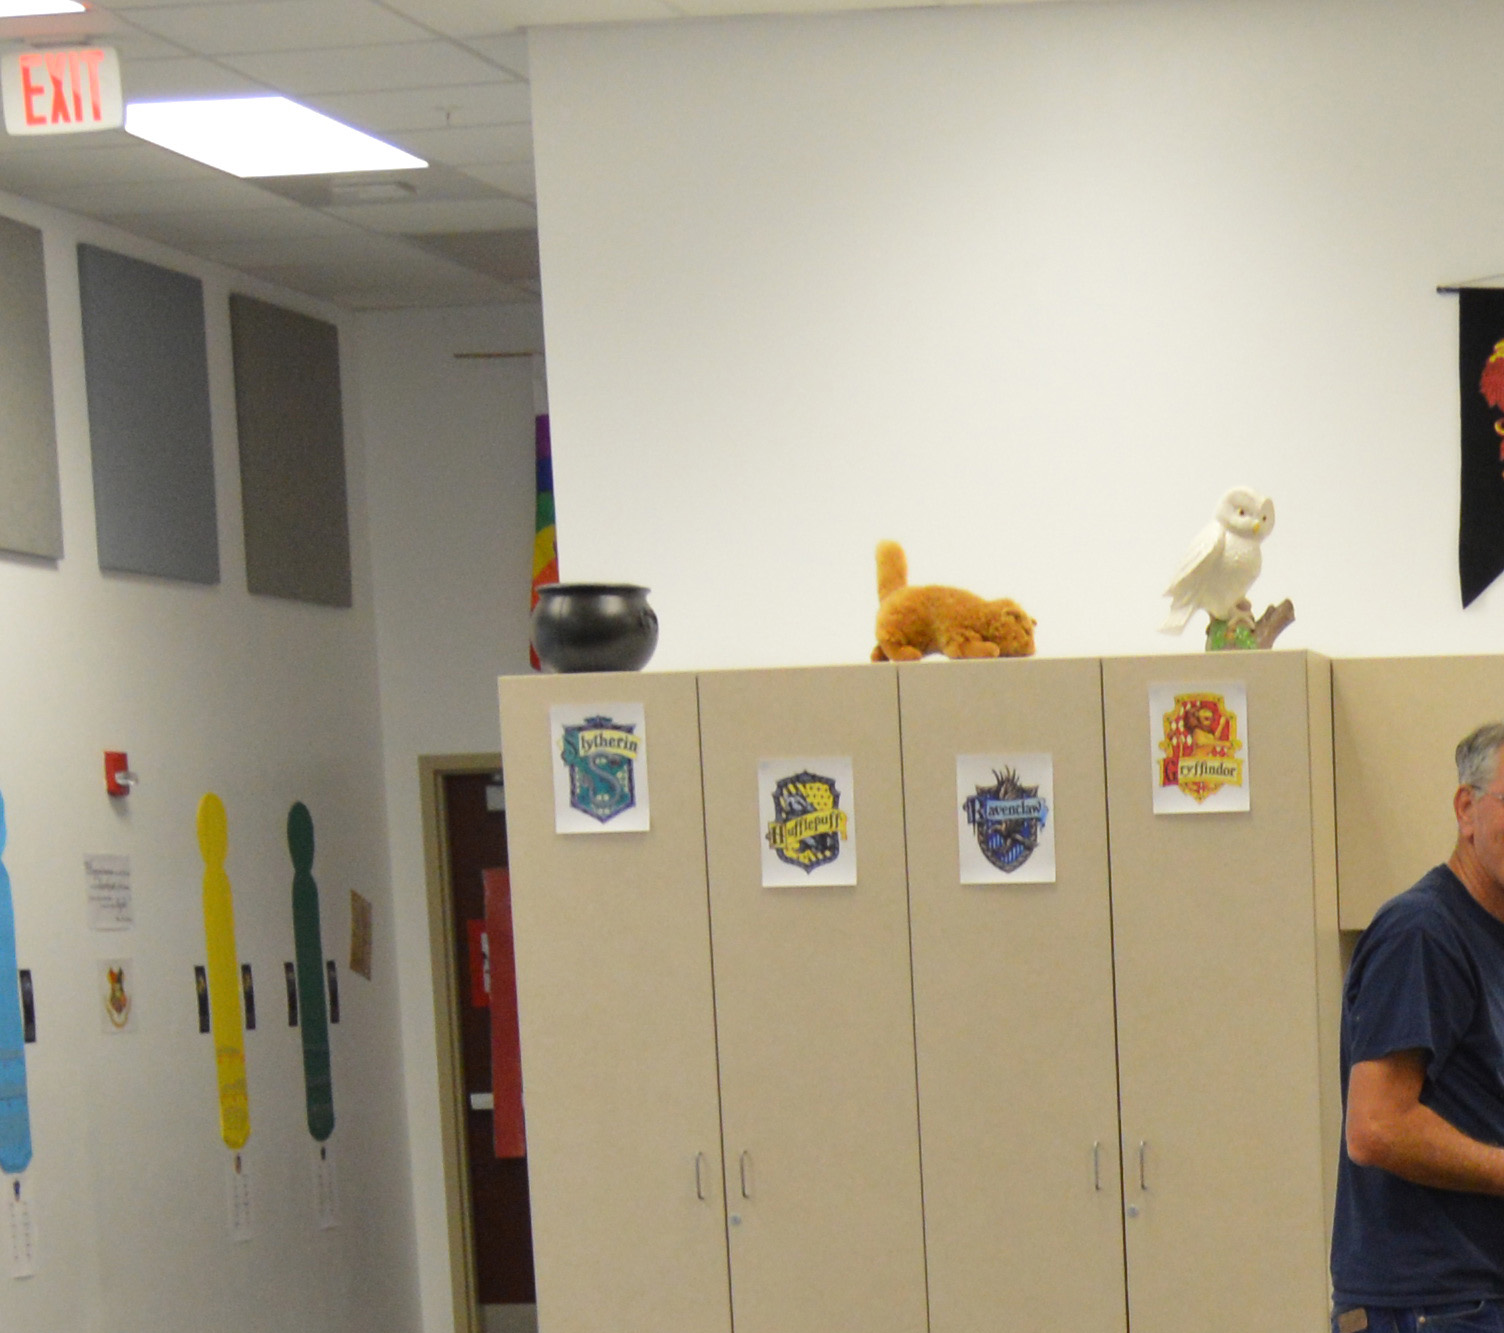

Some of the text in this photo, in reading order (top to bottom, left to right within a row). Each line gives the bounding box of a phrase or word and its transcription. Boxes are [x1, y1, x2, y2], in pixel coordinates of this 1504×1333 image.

[19, 50, 104, 126] EXIT
[562, 732, 639, 766] Slytherin
[1165, 759, 1237, 783] Gryffindor
[969, 798, 1043, 822] Ravenclaw
[771, 811, 841, 846] Hufflepuff
